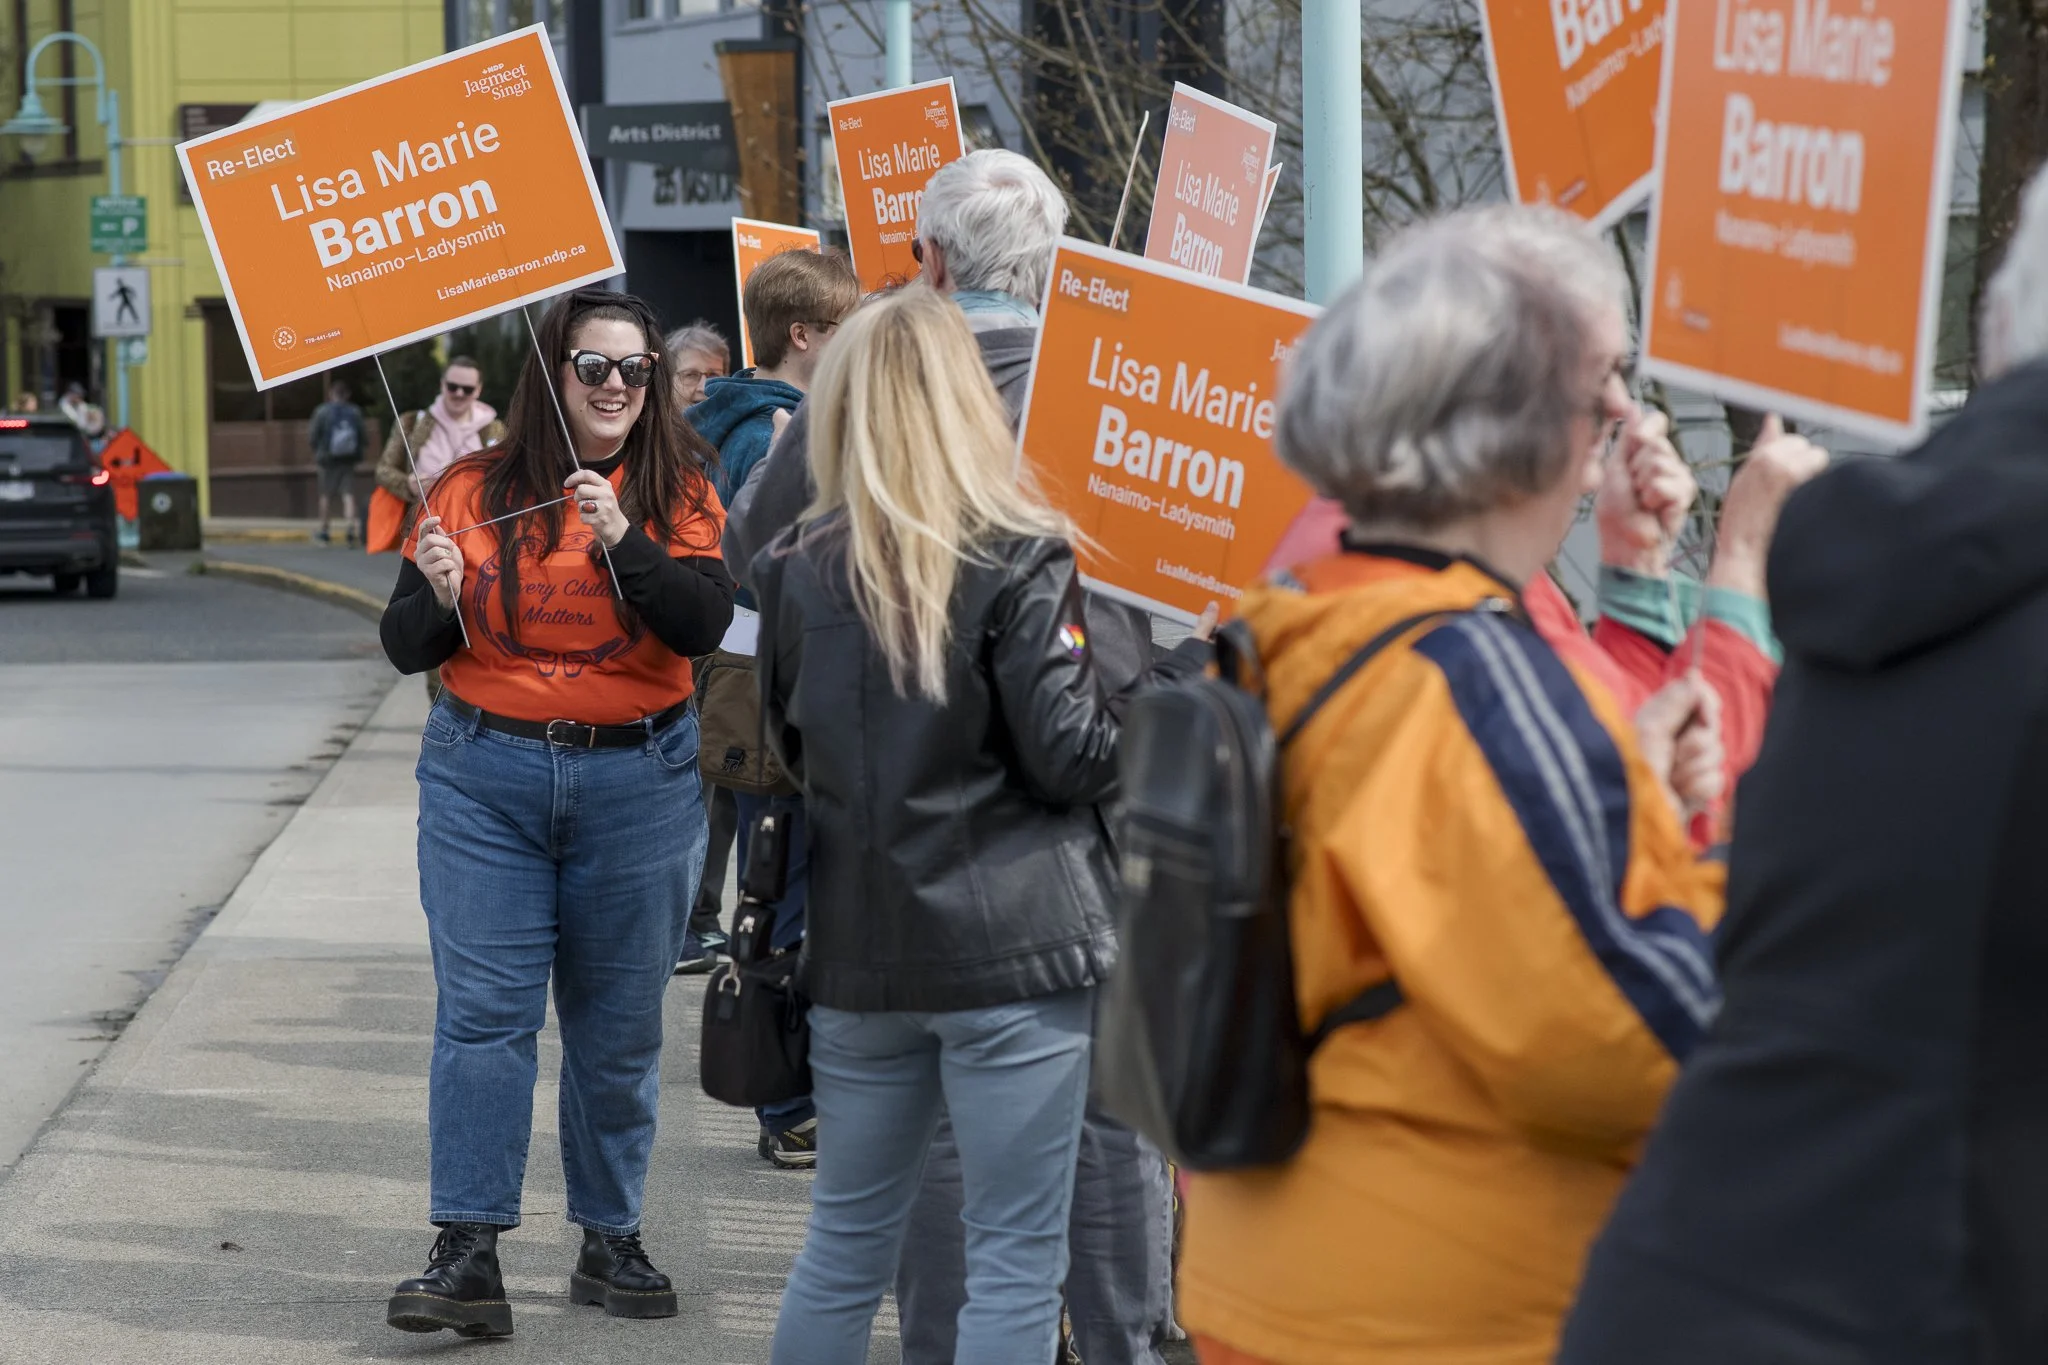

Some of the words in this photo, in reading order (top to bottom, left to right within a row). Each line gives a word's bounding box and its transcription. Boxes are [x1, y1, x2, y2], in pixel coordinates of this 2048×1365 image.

[463, 64, 527, 97] Jagmeet
[491, 78, 532, 100] Singh
[608, 125, 648, 143] Arts
[651, 122, 722, 142] District
[839, 117, 863, 131] Re-Elect
[1170, 106, 1196, 133] Re-Elect
[206, 138, 296, 180] Re-Elect
[270, 167, 366, 221] Lisa
[371, 121, 501, 187] Marie
[858, 147, 892, 180] Lisa
[893, 137, 941, 174] Marie
[1718, 92, 1865, 214] Barron
[1174, 159, 1202, 208] Lisa
[1201, 172, 1239, 227] Marie
[309, 179, 498, 268] Barron
[1170, 212, 1223, 279] Barron
[436, 243, 587, 301] LisaMarieBarron.ndp.ca
[1058, 268, 1131, 313] Re-Elect
[1088, 337, 1161, 404] Lisa
[1170, 361, 1276, 440] Marie
[1092, 404, 1245, 508] Barron
[521, 604, 595, 626] Matters
